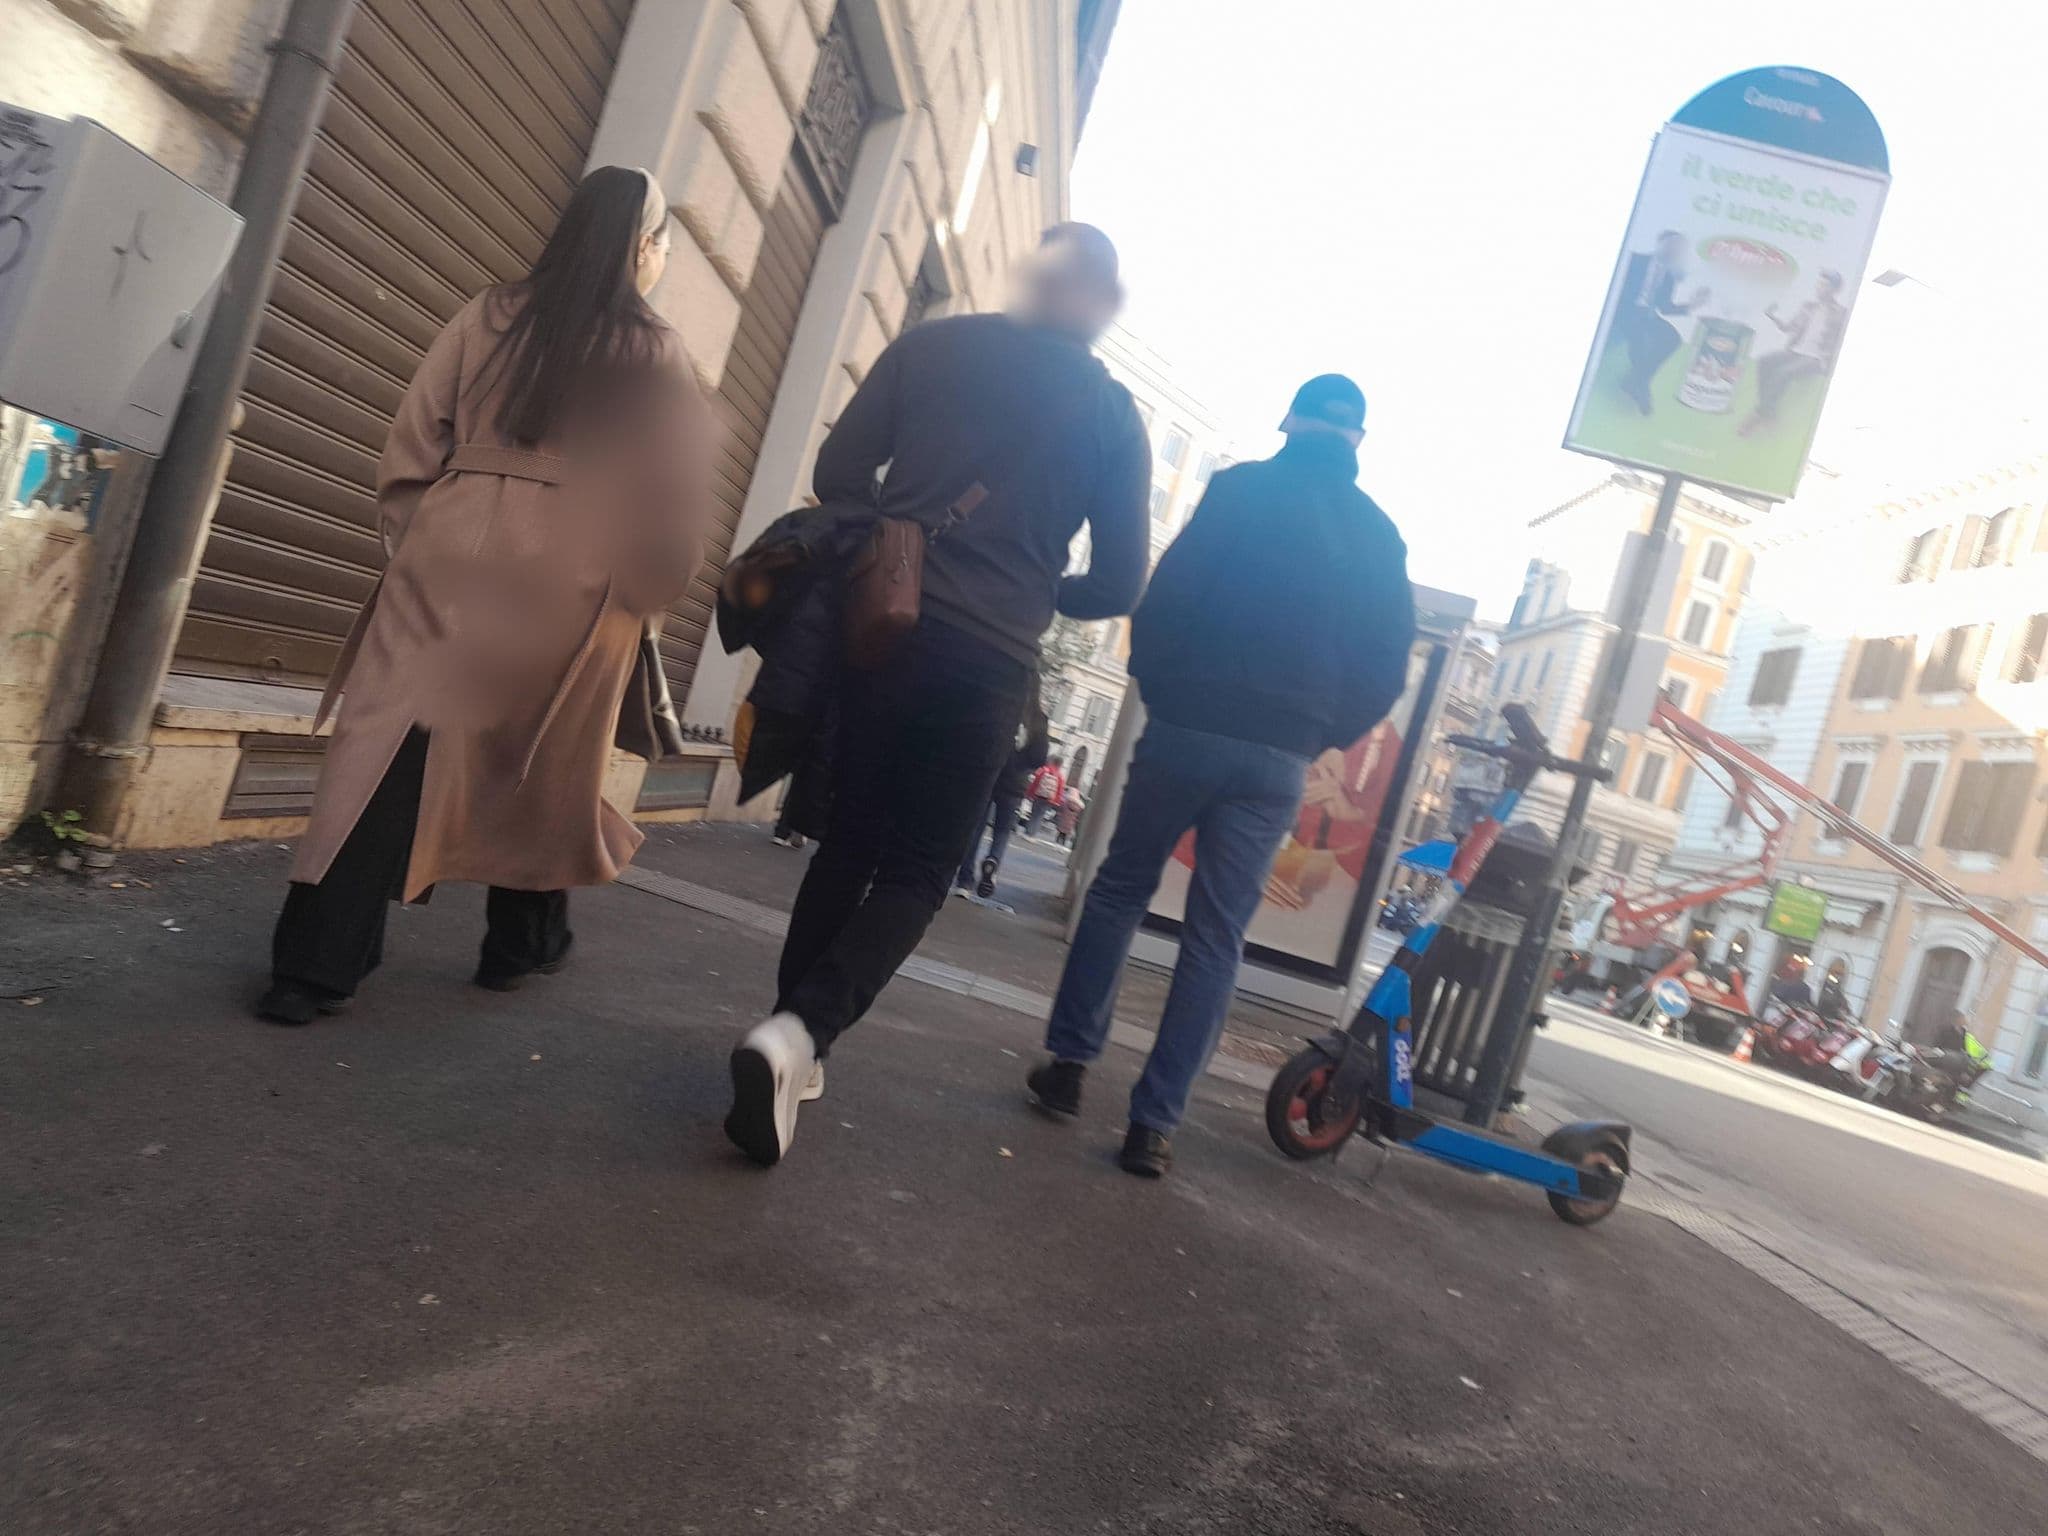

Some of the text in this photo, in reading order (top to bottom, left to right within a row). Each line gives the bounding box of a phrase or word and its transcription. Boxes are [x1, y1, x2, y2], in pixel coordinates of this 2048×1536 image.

[1710, 166, 1794, 200] verde
[1802, 187, 1857, 217] che
[1728, 202, 1827, 241] unisce
